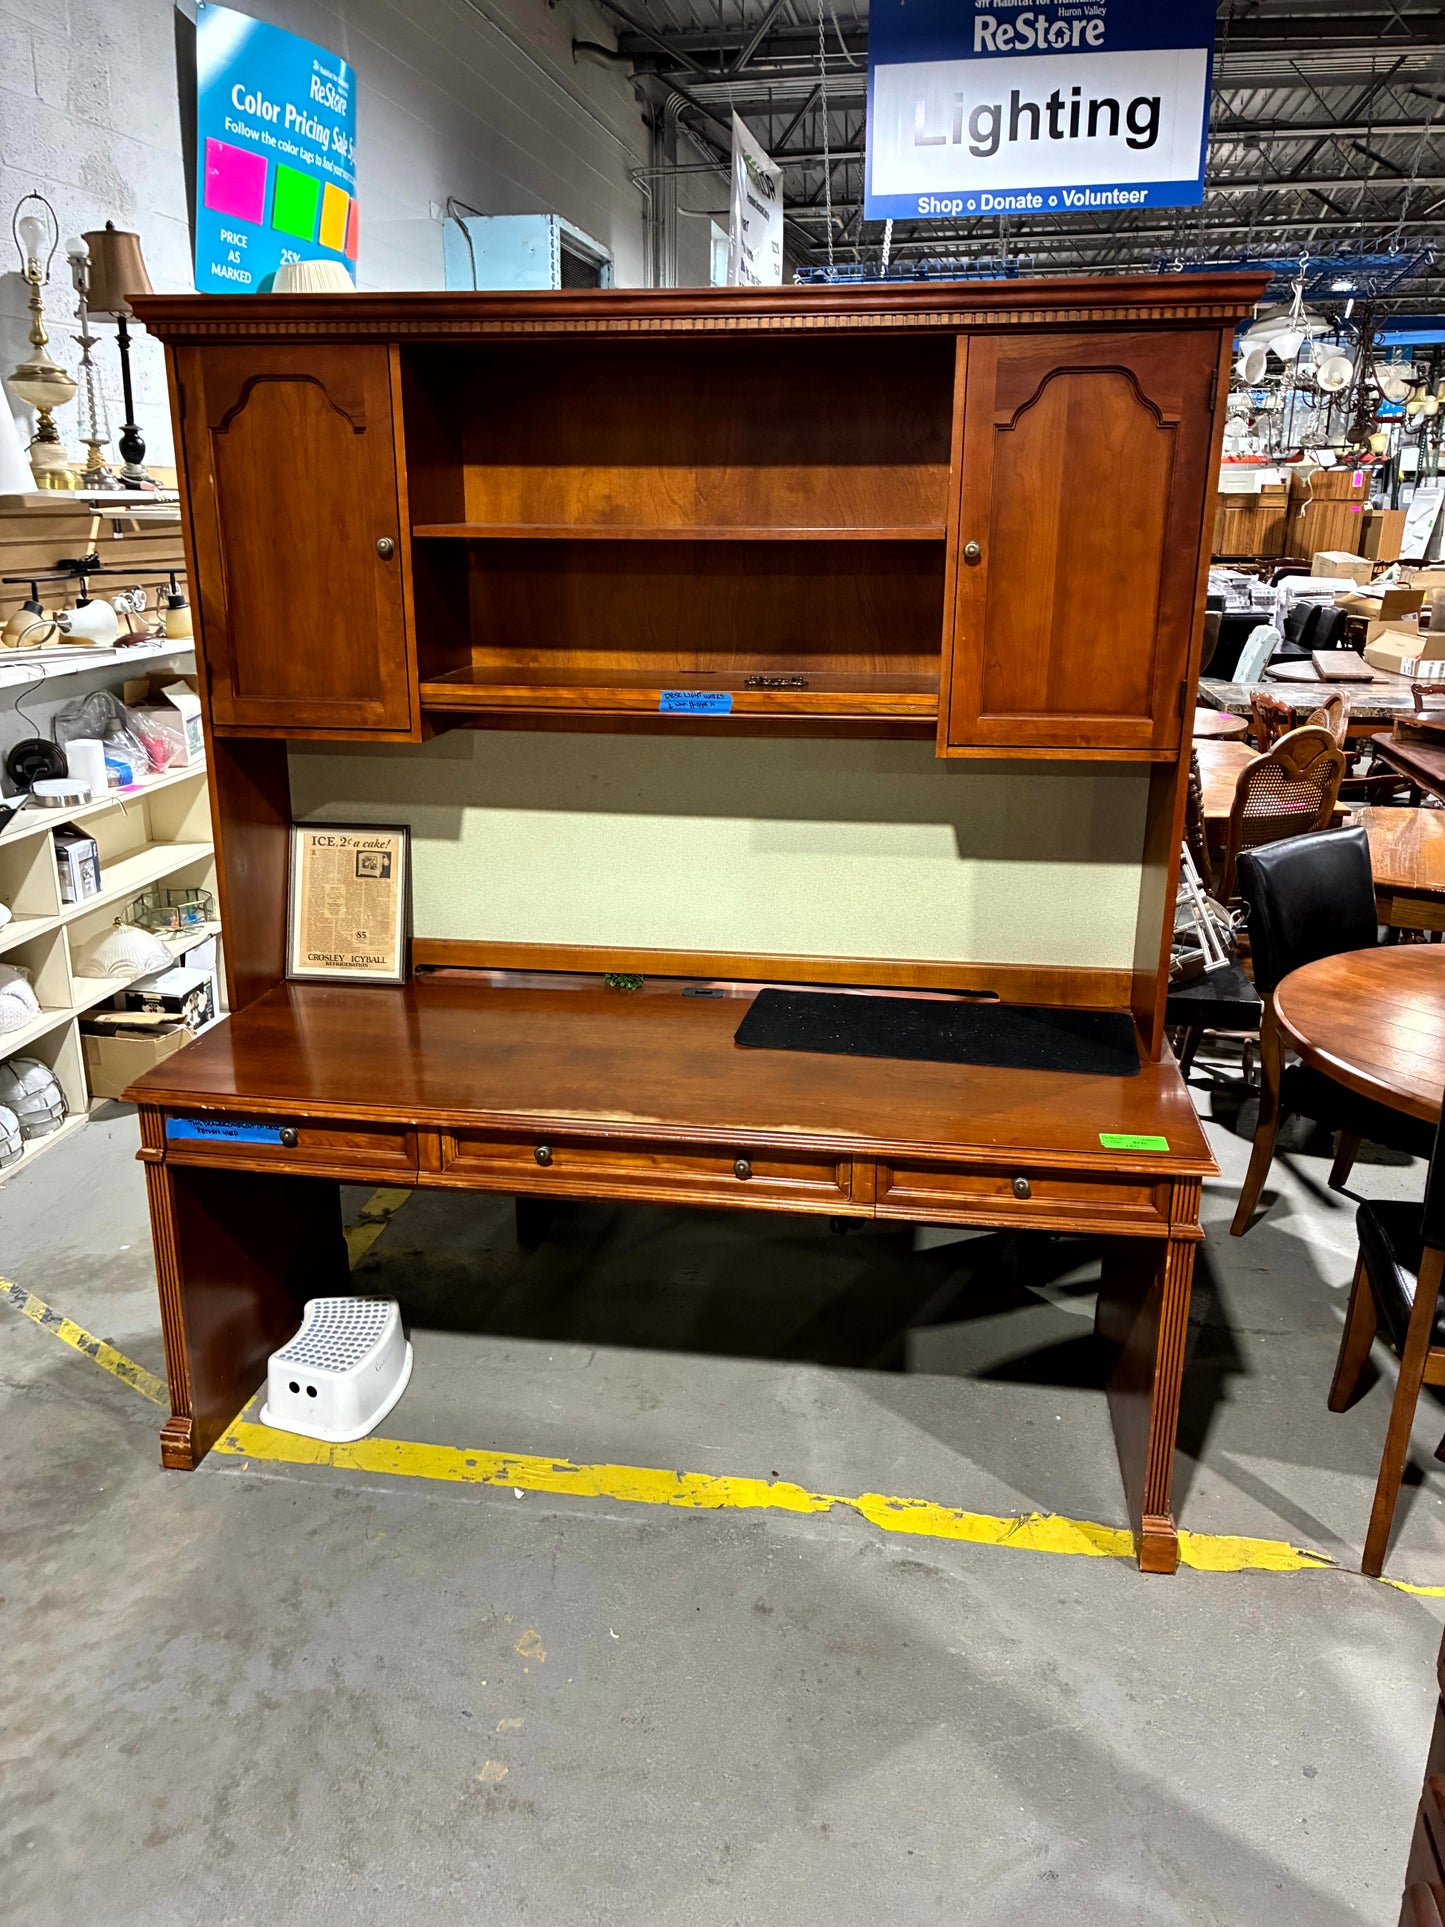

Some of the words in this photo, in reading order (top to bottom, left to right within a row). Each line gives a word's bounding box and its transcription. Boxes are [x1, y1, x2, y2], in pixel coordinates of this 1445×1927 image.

[1058, 7, 1082, 17] Huron
[1084, 6, 1107, 17] Valley
[973, 12, 1105, 52] ReStore
[310, 74, 347, 116] ReStore
[231, 83, 281, 124] Color
[284, 102, 330, 151] Pricing
[914, 86, 1161, 157] Lighting
[224, 116, 260, 141] Follow
[261, 131, 277, 148] the
[277, 139, 299, 156] color
[299, 147, 315, 164] tags
[917, 197, 963, 215] Shop
[980, 193, 1043, 211] Donate
[1062, 189, 1148, 207] Volunteer
[220, 228, 248, 249] PRICE
[227, 249, 241, 264] AS
[211, 262, 252, 284] MARKED
[307, 953, 345, 963] CROSLEY
